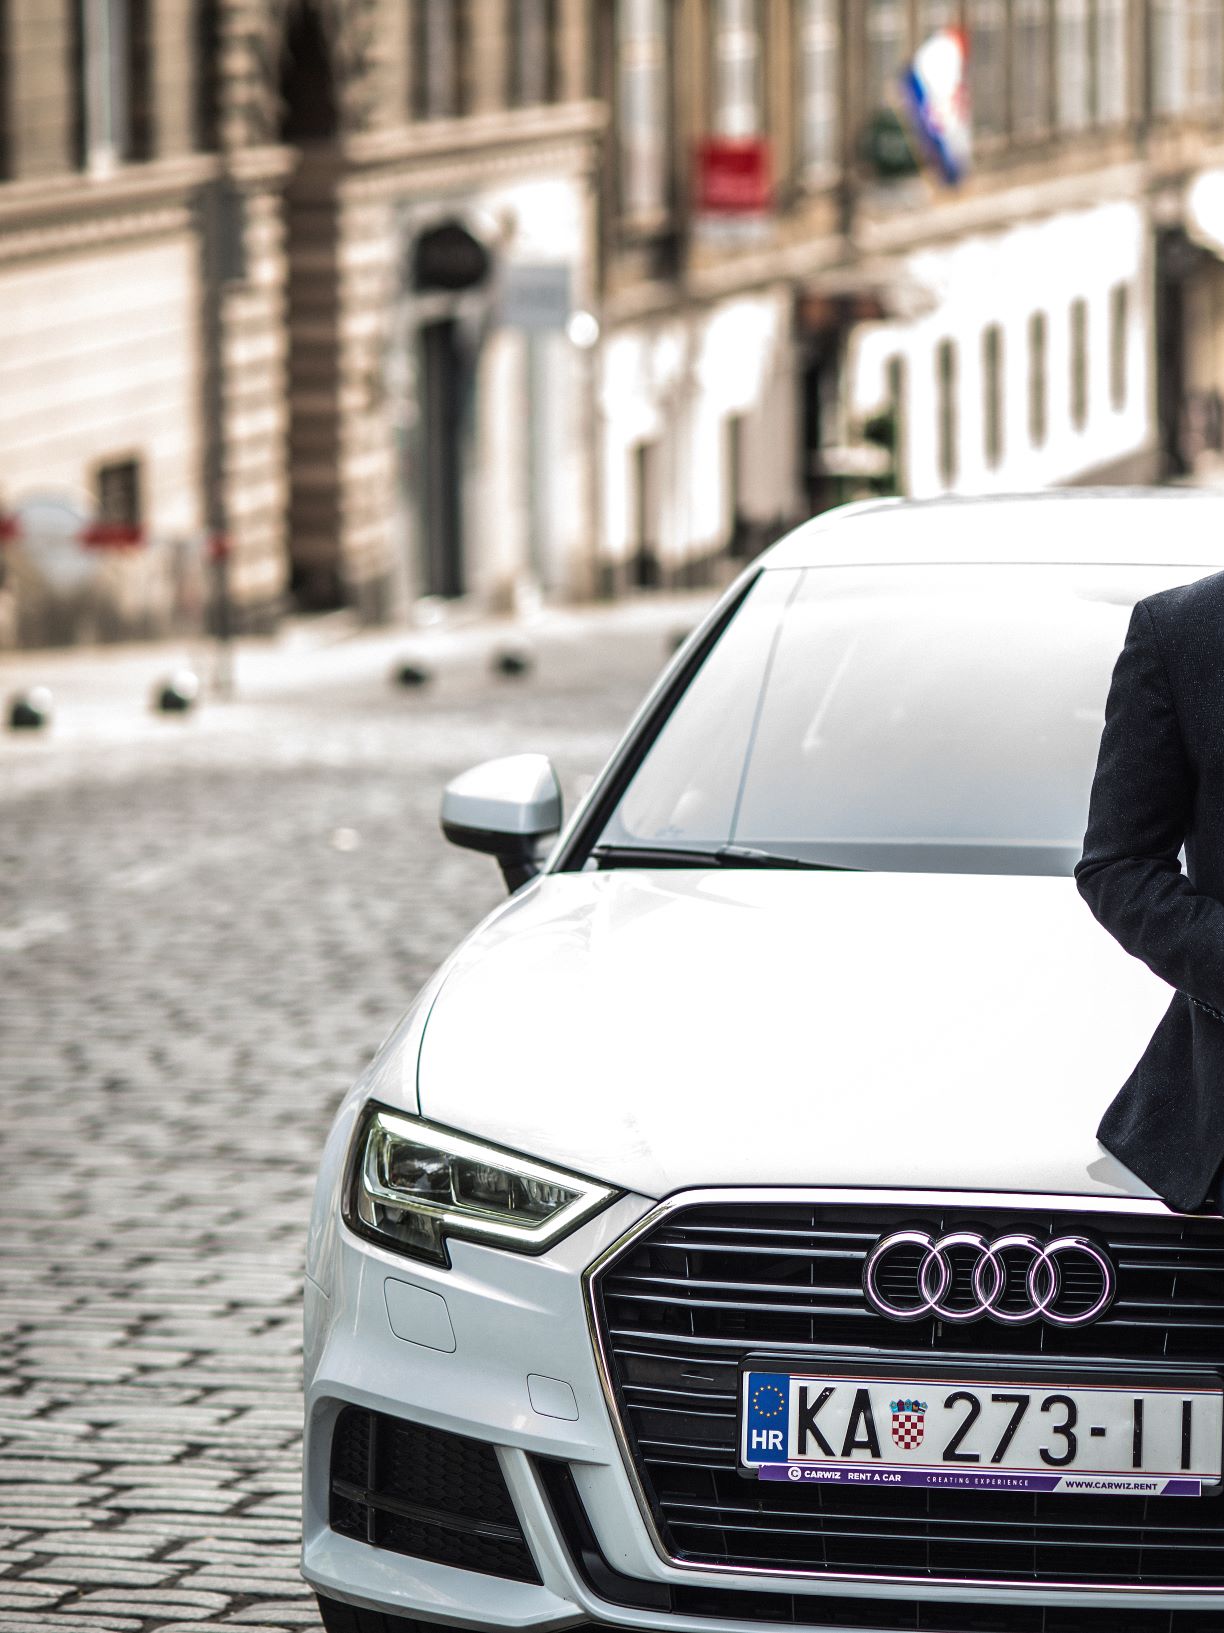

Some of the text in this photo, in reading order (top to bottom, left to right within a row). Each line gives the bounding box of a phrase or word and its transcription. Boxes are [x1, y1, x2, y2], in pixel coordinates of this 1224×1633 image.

[798, 1386, 882, 1458] KA
[751, 1430, 783, 1450] HR
[804, 1470, 841, 1479] CARWIZ
[848, 1472, 871, 1481] RENT
[882, 1474, 901, 1482] CAR
[926, 1476, 969, 1484] CREATING
[974, 1478, 1029, 1486] EXPERIENCE
[1065, 1481, 1158, 1491] WWW.CARWIZ.RENT
